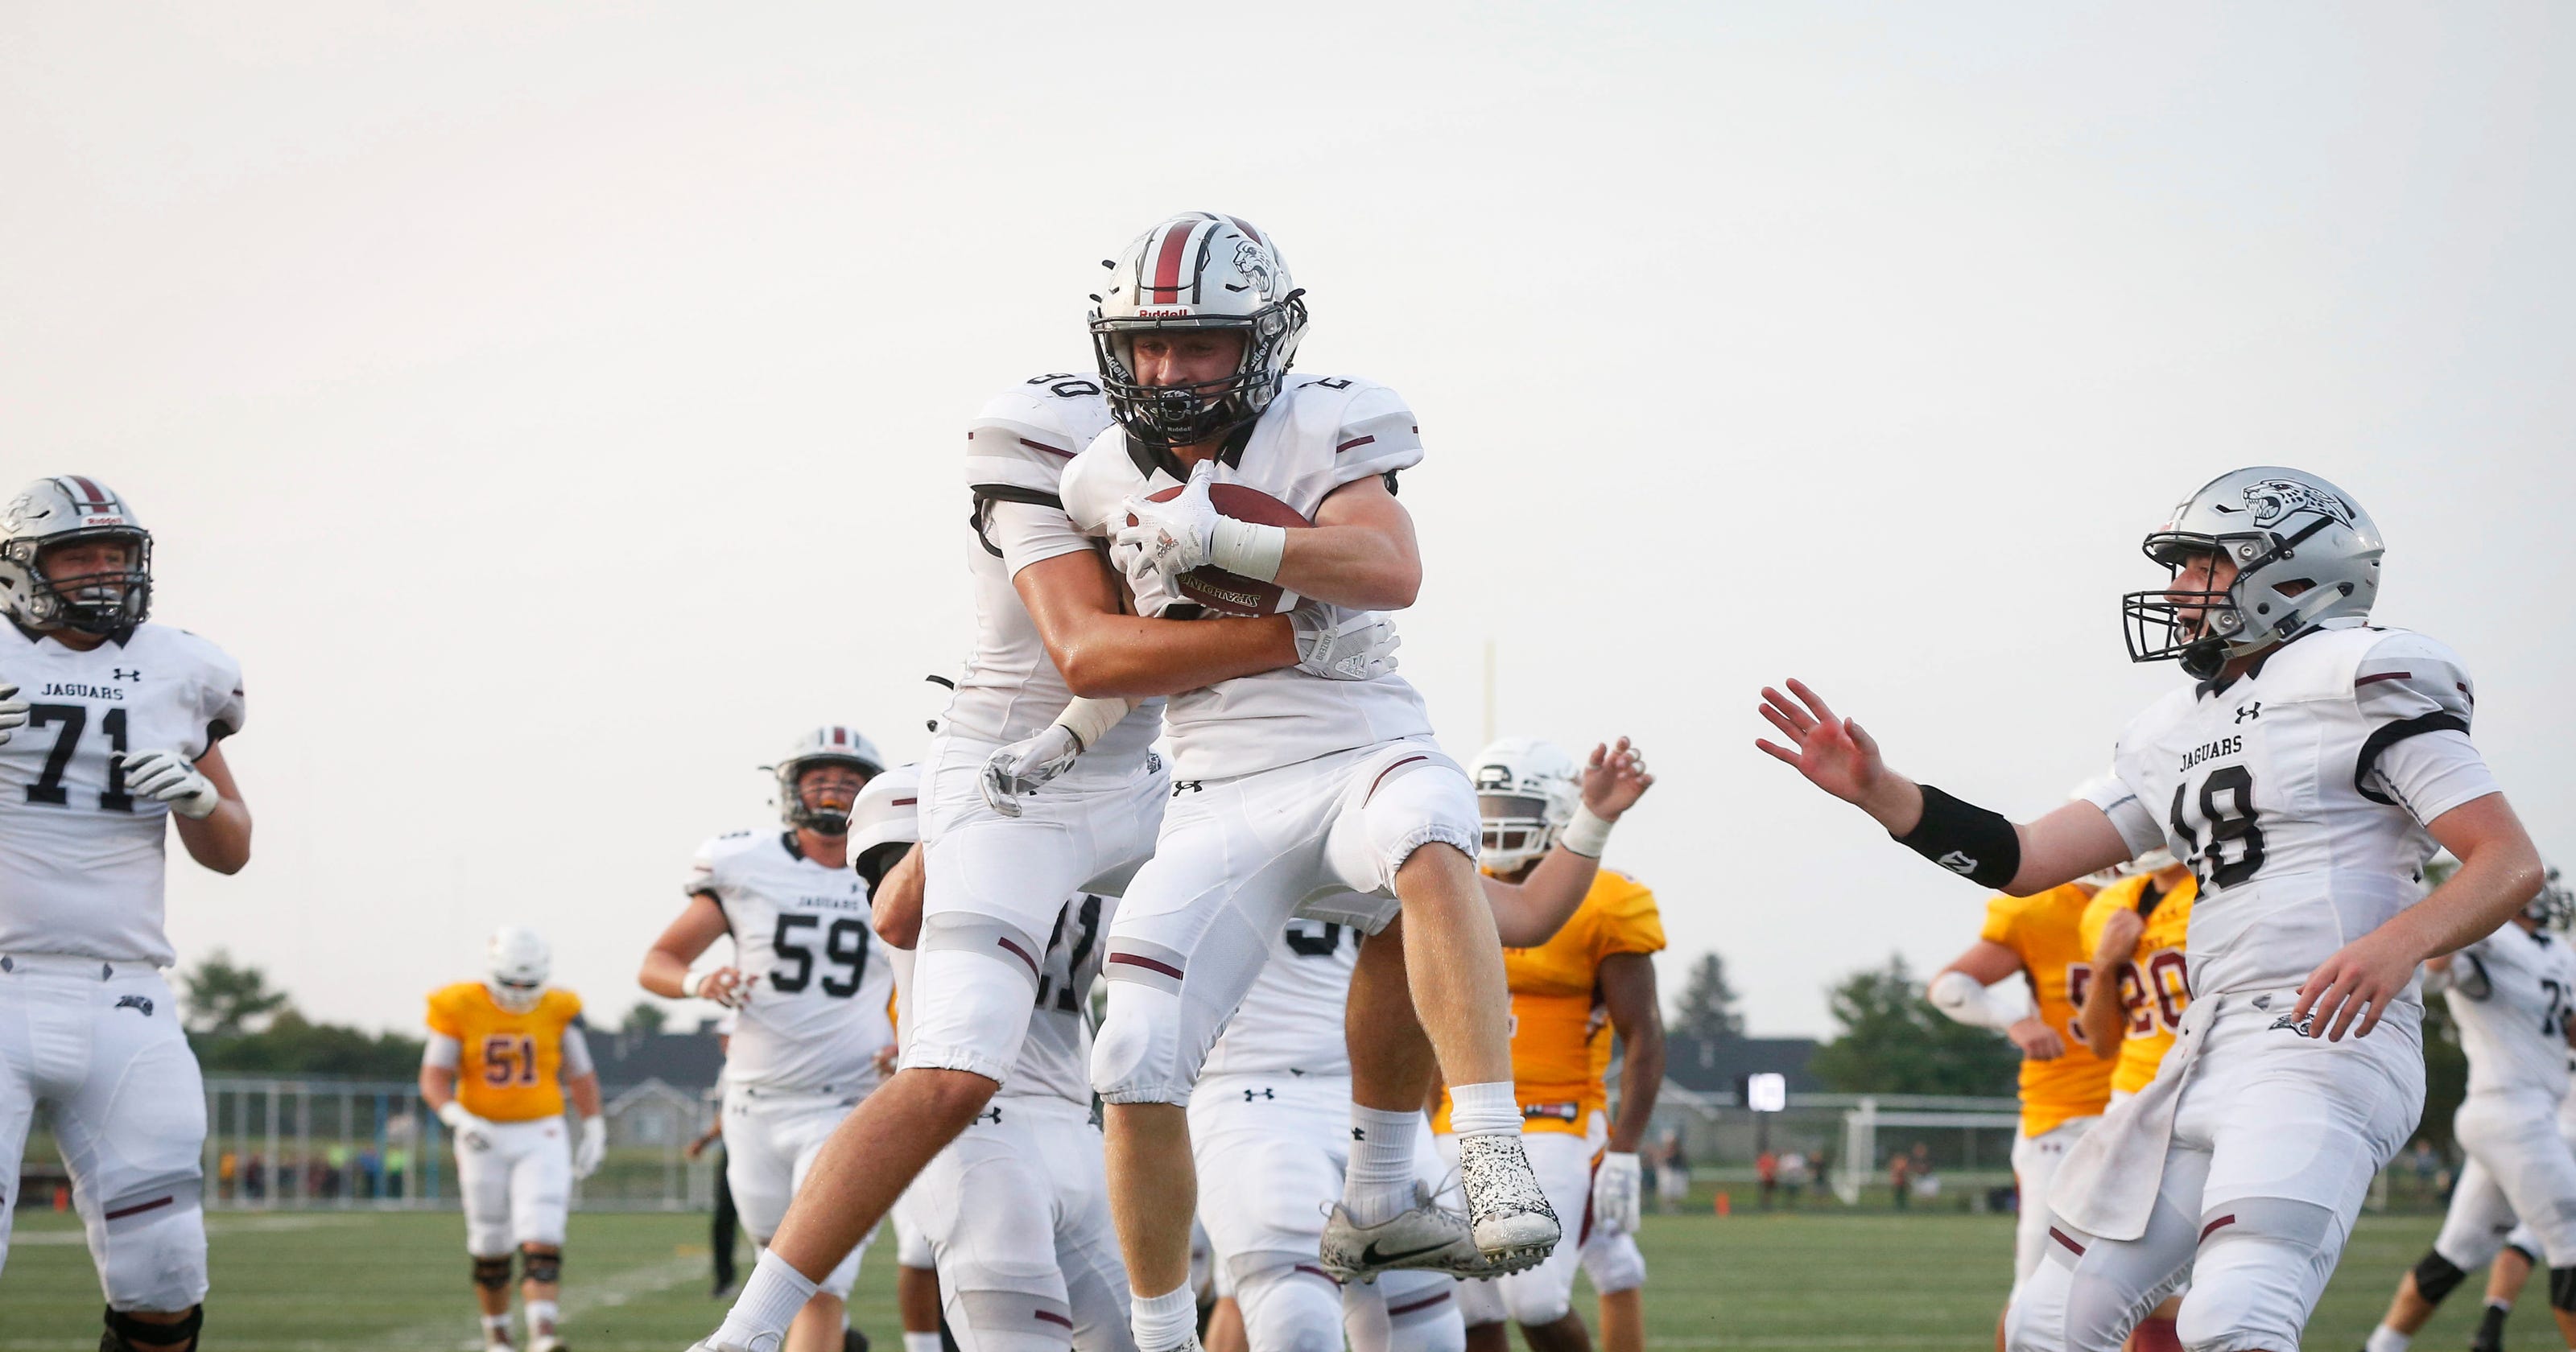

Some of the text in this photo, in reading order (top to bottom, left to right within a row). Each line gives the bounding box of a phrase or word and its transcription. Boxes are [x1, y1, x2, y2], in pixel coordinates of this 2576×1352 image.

[1106, 353, 1129, 379] ddell
[1240, 341, 1269, 374] Rddell
[41, 682, 124, 701] JAGUARS
[27, 703, 134, 813] 71
[2179, 735, 2242, 773] JAGUARS
[2170, 765, 2265, 903] 18
[769, 913, 869, 999] 59
[2117, 948, 2194, 1038] 20
[483, 1036, 539, 1088] 51
